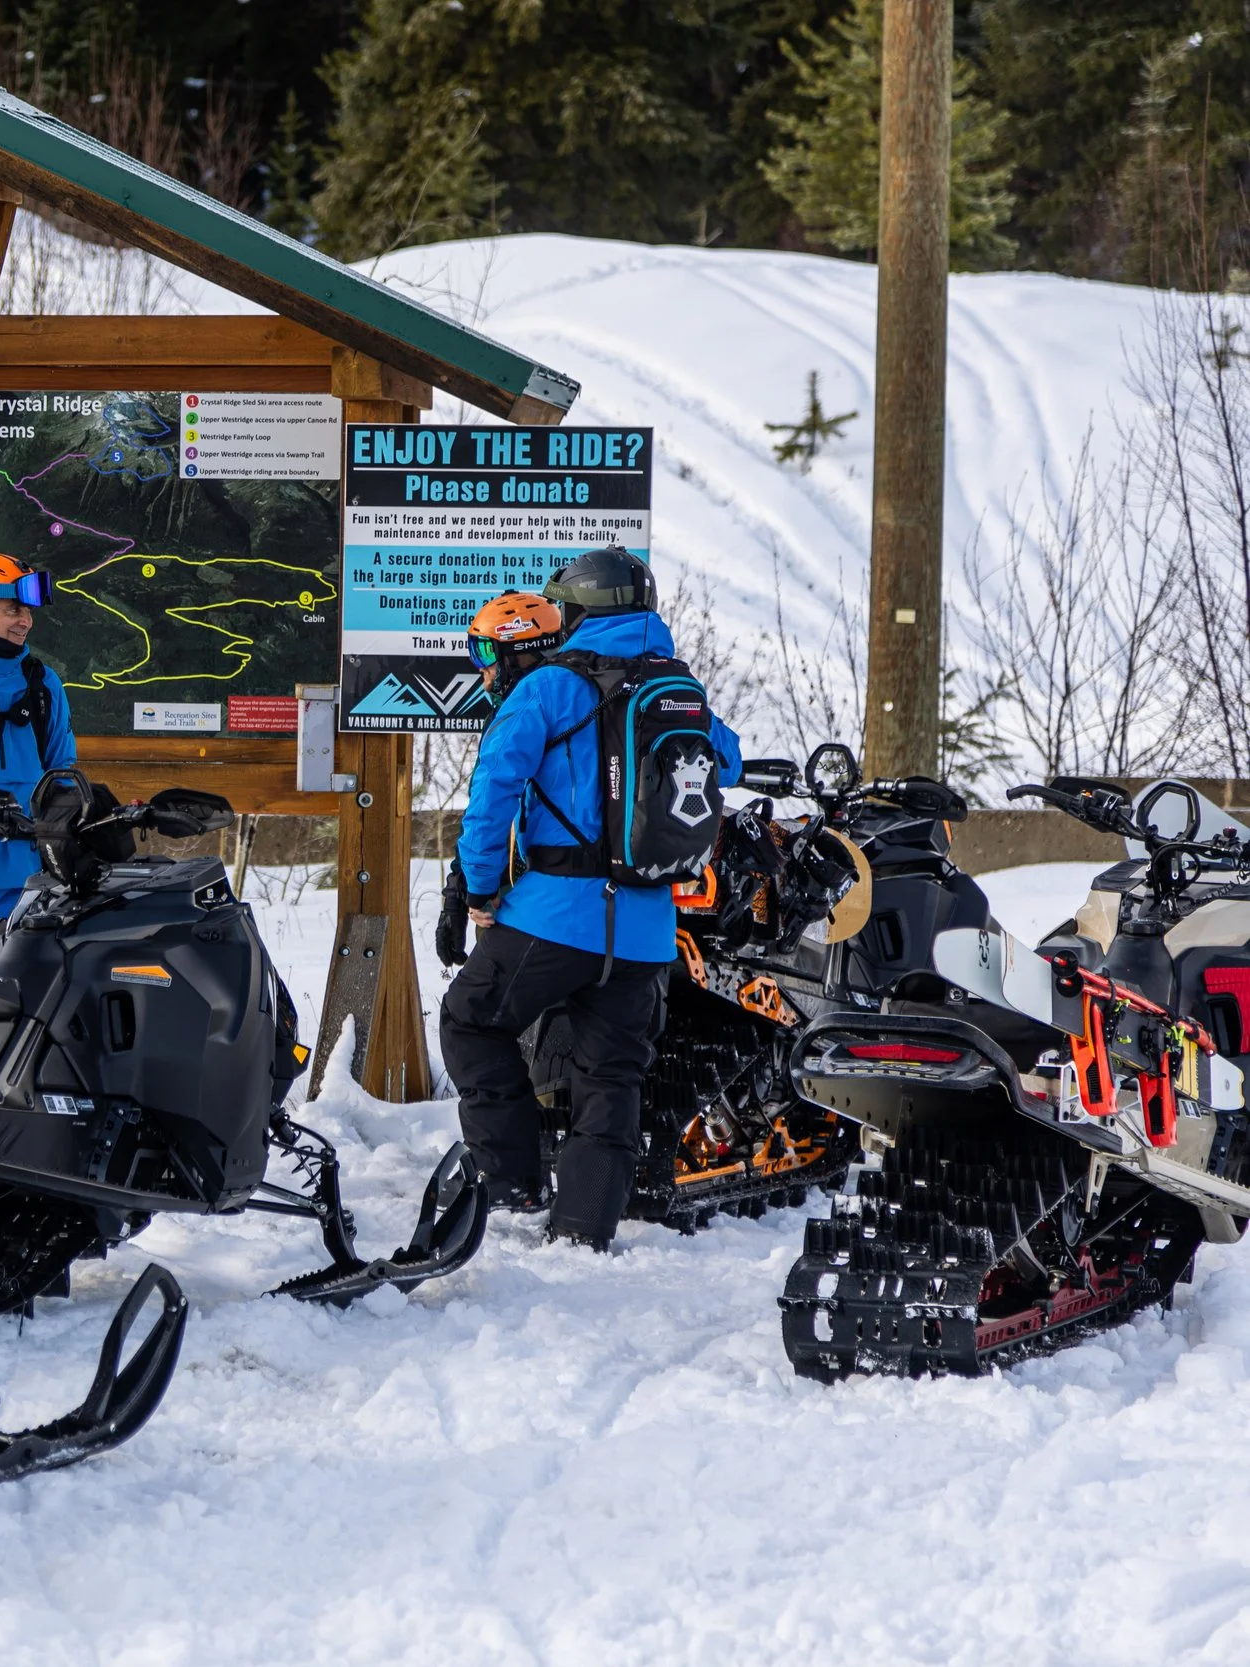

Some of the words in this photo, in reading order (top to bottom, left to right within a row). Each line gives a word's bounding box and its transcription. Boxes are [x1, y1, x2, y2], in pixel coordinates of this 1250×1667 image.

[54, 395, 102, 415] Ridge
[221, 451, 252, 459] Westridge
[354, 430, 457, 465] ENJOY
[471, 432, 532, 465] THE
[548, 433, 643, 467] RIDE?
[406, 475, 490, 502] Please
[502, 476, 590, 503] donate
[353, 514, 370, 524] Fun
[375, 514, 398, 524] isn't
[403, 514, 424, 524] free
[429, 515, 447, 525] and
[452, 517, 466, 525] we
[471, 515, 495, 525] need
[500, 518, 523, 527] your
[528, 516, 549, 528] help
[553, 516, 576, 527] with
[581, 517, 597, 527] the
[602, 517, 642, 529] ongoing
[374, 528, 440, 539] maintenance
[445, 529, 463, 539] and
[468, 530, 534, 541] development
[539, 530, 549, 540] of
[554, 530, 573, 541] this
[579, 530, 620, 543] facility.
[374, 552, 381, 565] A
[388, 554, 433, 565] secure
[439, 553, 496, 566] donation
[502, 554, 525, 567] box
[532, 554, 543, 567] is
[550, 555, 576, 567] loca
[354, 569, 374, 582] the
[380, 569, 414, 585] large
[420, 570, 447, 586] sign
[454, 571, 498, 584] boards
[504, 572, 515, 584] in
[523, 572, 542, 584] the
[380, 595, 446, 609] Donations
[453, 599, 476, 609] can
[303, 614, 325, 623] Cabin
[412, 637, 445, 649] Thank
[514, 637, 555, 650] SMITH
[348, 717, 404, 728] VALEMOUNT
[407, 718, 414, 728] &
[417, 718, 441, 729] AREA
[445, 718, 484, 730] RECREAT
